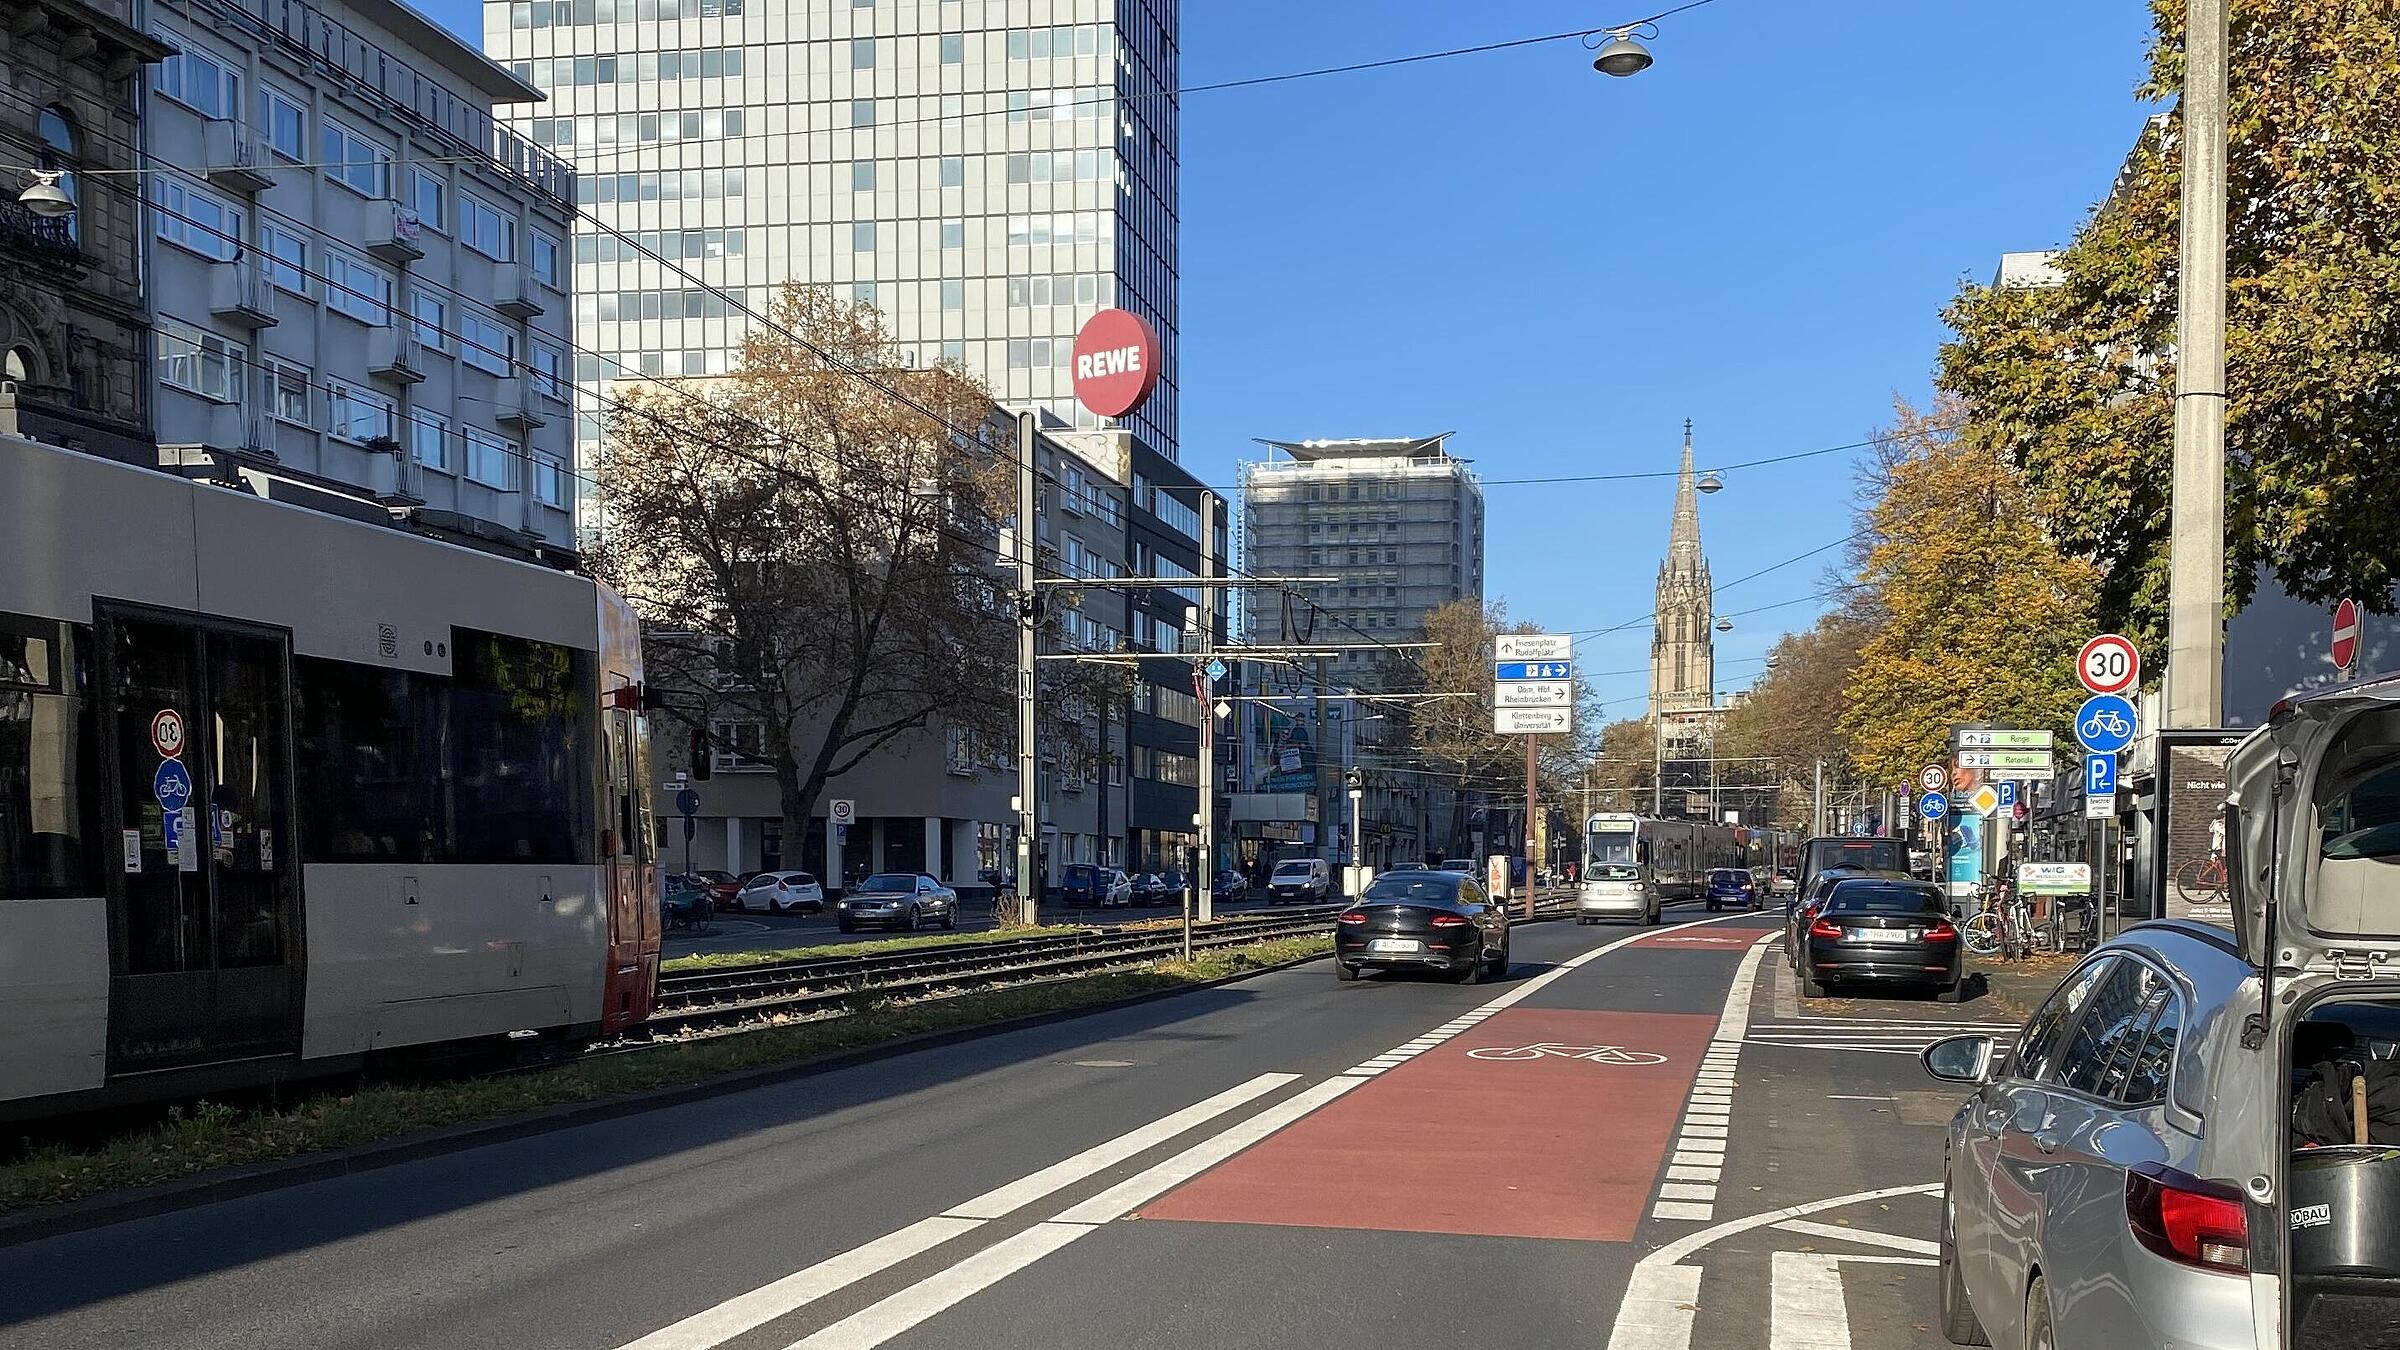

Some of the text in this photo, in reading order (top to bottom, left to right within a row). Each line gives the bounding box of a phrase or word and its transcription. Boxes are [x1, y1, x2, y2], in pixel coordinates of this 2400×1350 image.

[1078, 345, 1141, 380] REWE
[1515, 639, 1556, 648] Friesenplatz
[1515, 648, 1554, 657] Rudolfplatz
[2091, 652, 2125, 677] 30
[1504, 695, 1552, 703] Rheinbrücken
[1511, 712, 1552, 720] Klettenberg
[1514, 721, 1551, 729] Universität
[1926, 772, 1941, 785] 30
[2091, 759, 2107, 790] P
[2187, 781, 2226, 789] Nicht wie
[2002, 784, 2011, 804] P
[838, 805, 848, 814] 30
